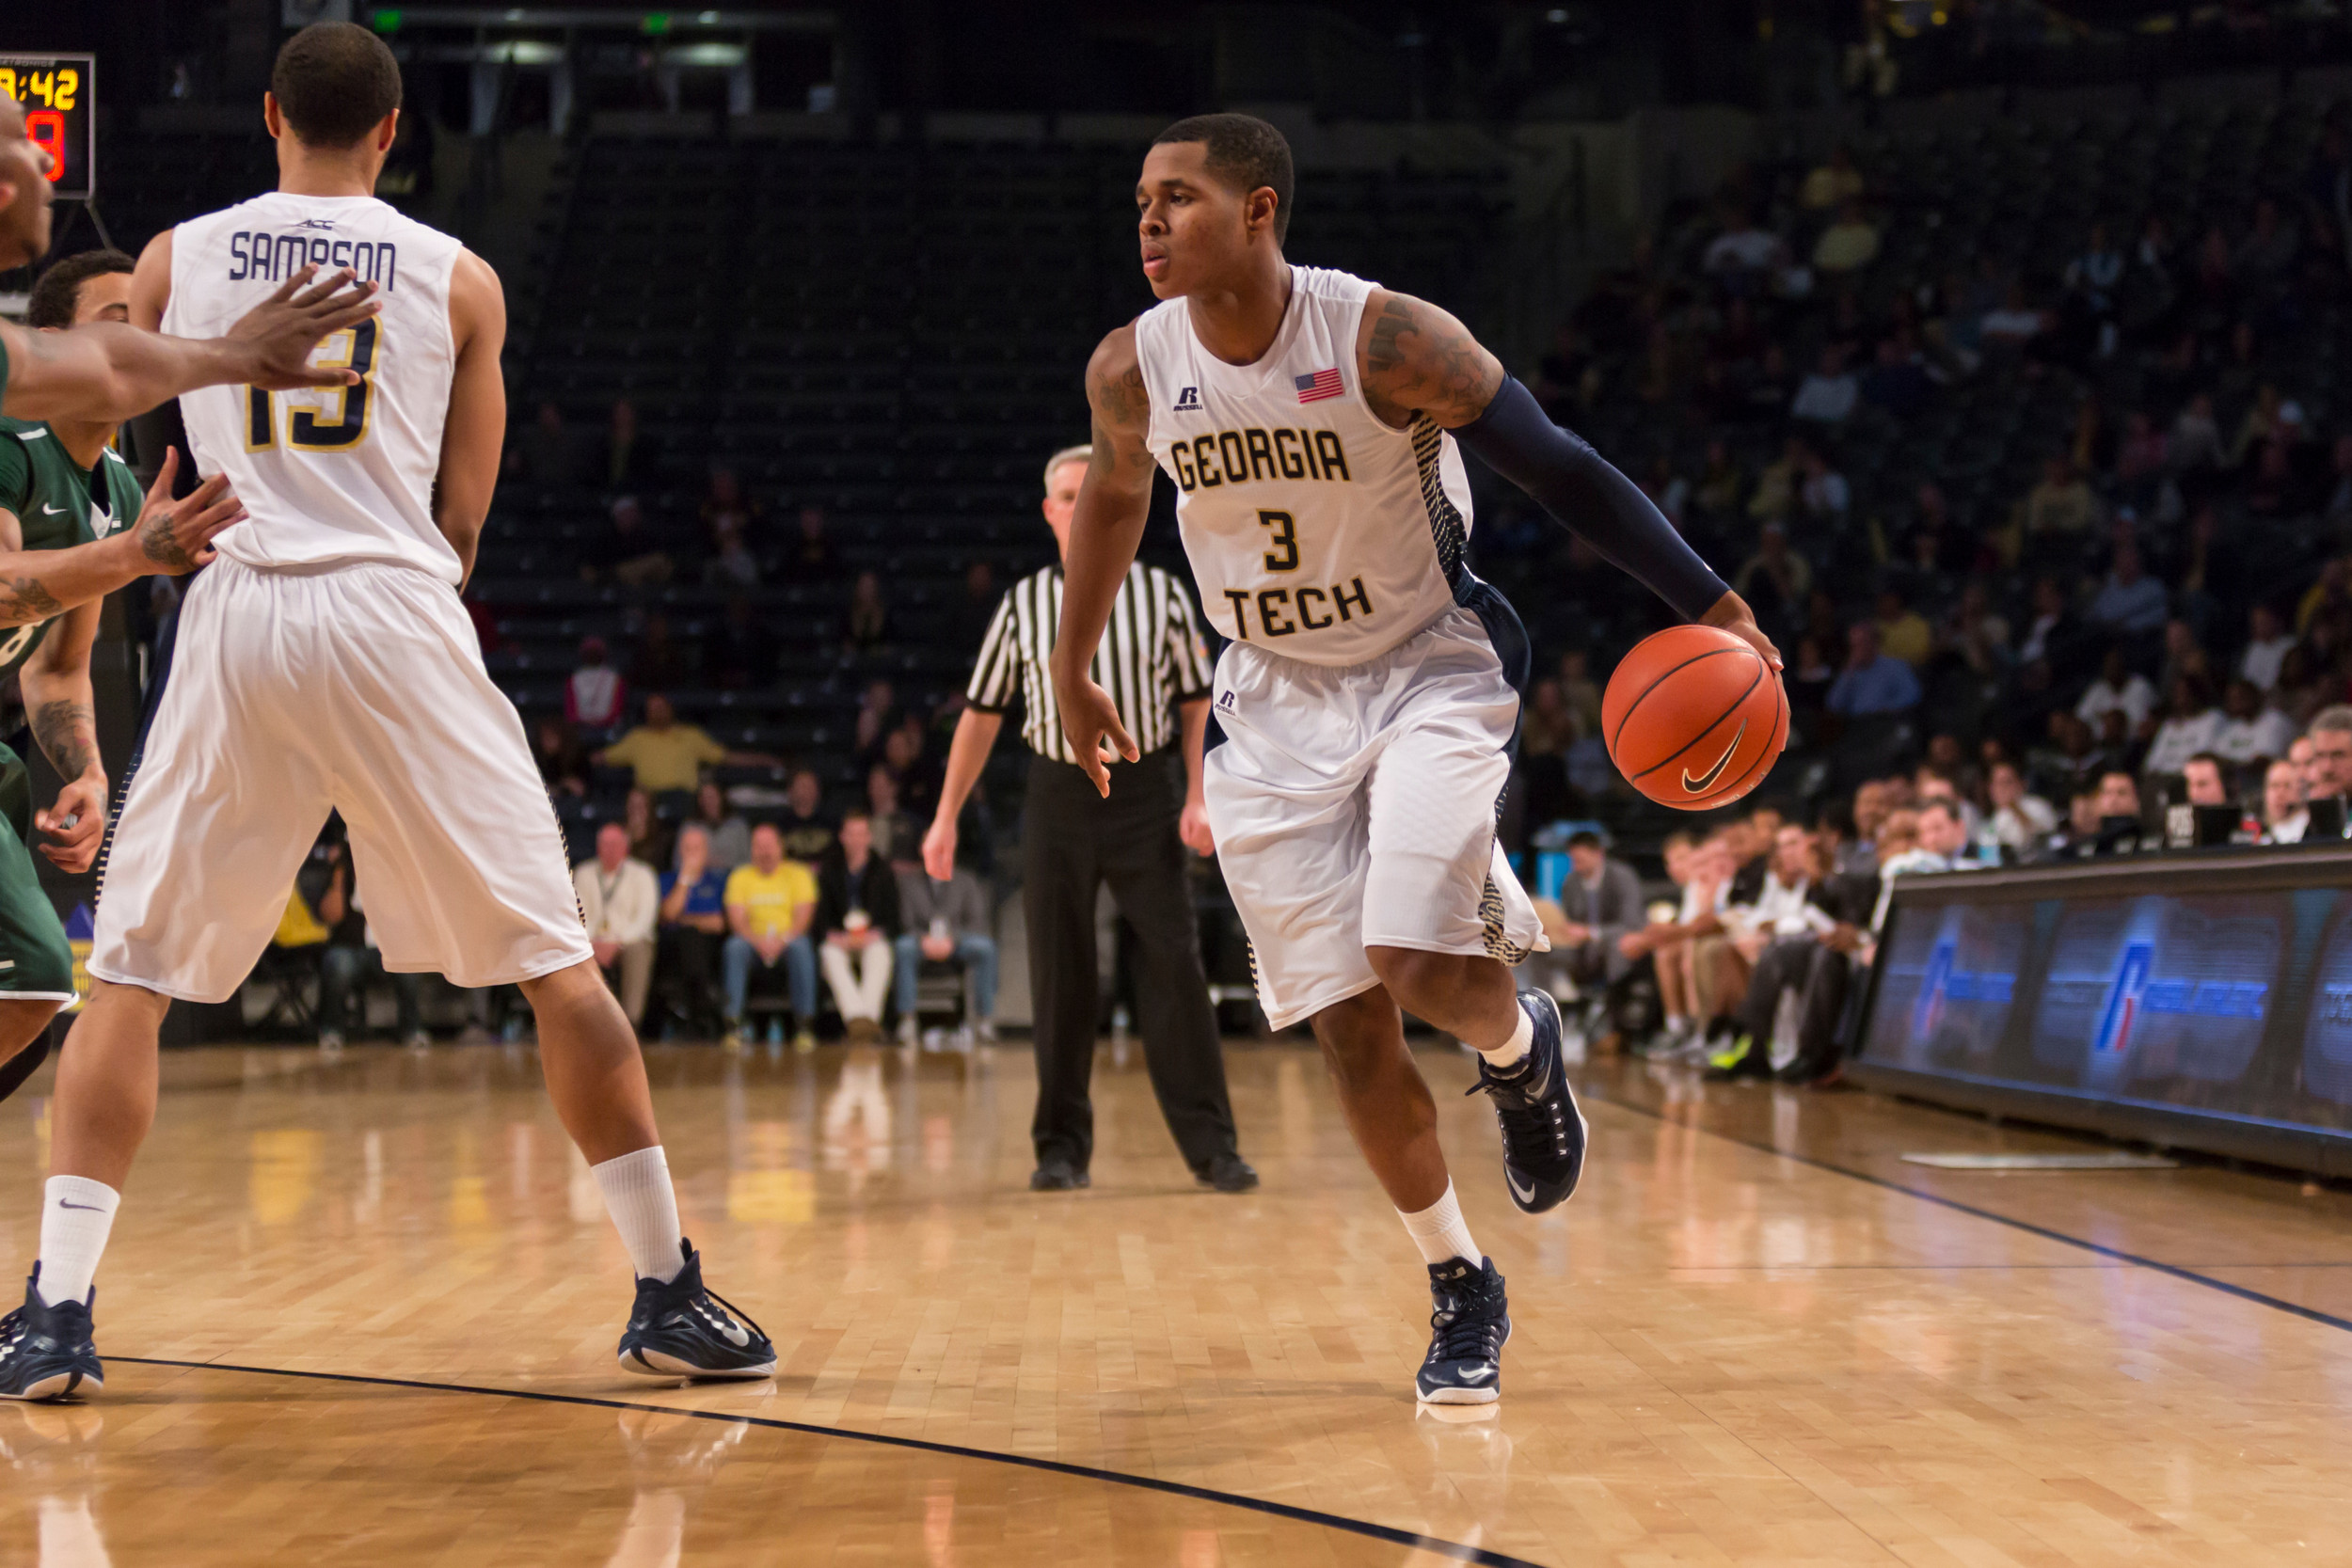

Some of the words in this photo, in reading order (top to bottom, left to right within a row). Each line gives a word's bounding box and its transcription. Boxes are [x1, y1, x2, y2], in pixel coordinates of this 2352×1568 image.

[294, 219, 336, 230] ACC
[229, 231, 396, 292] SAMPSON
[1170, 428, 1352, 493] GEORGIA
[1256, 508, 1300, 574] 3
[1224, 576, 1375, 640] TECH
